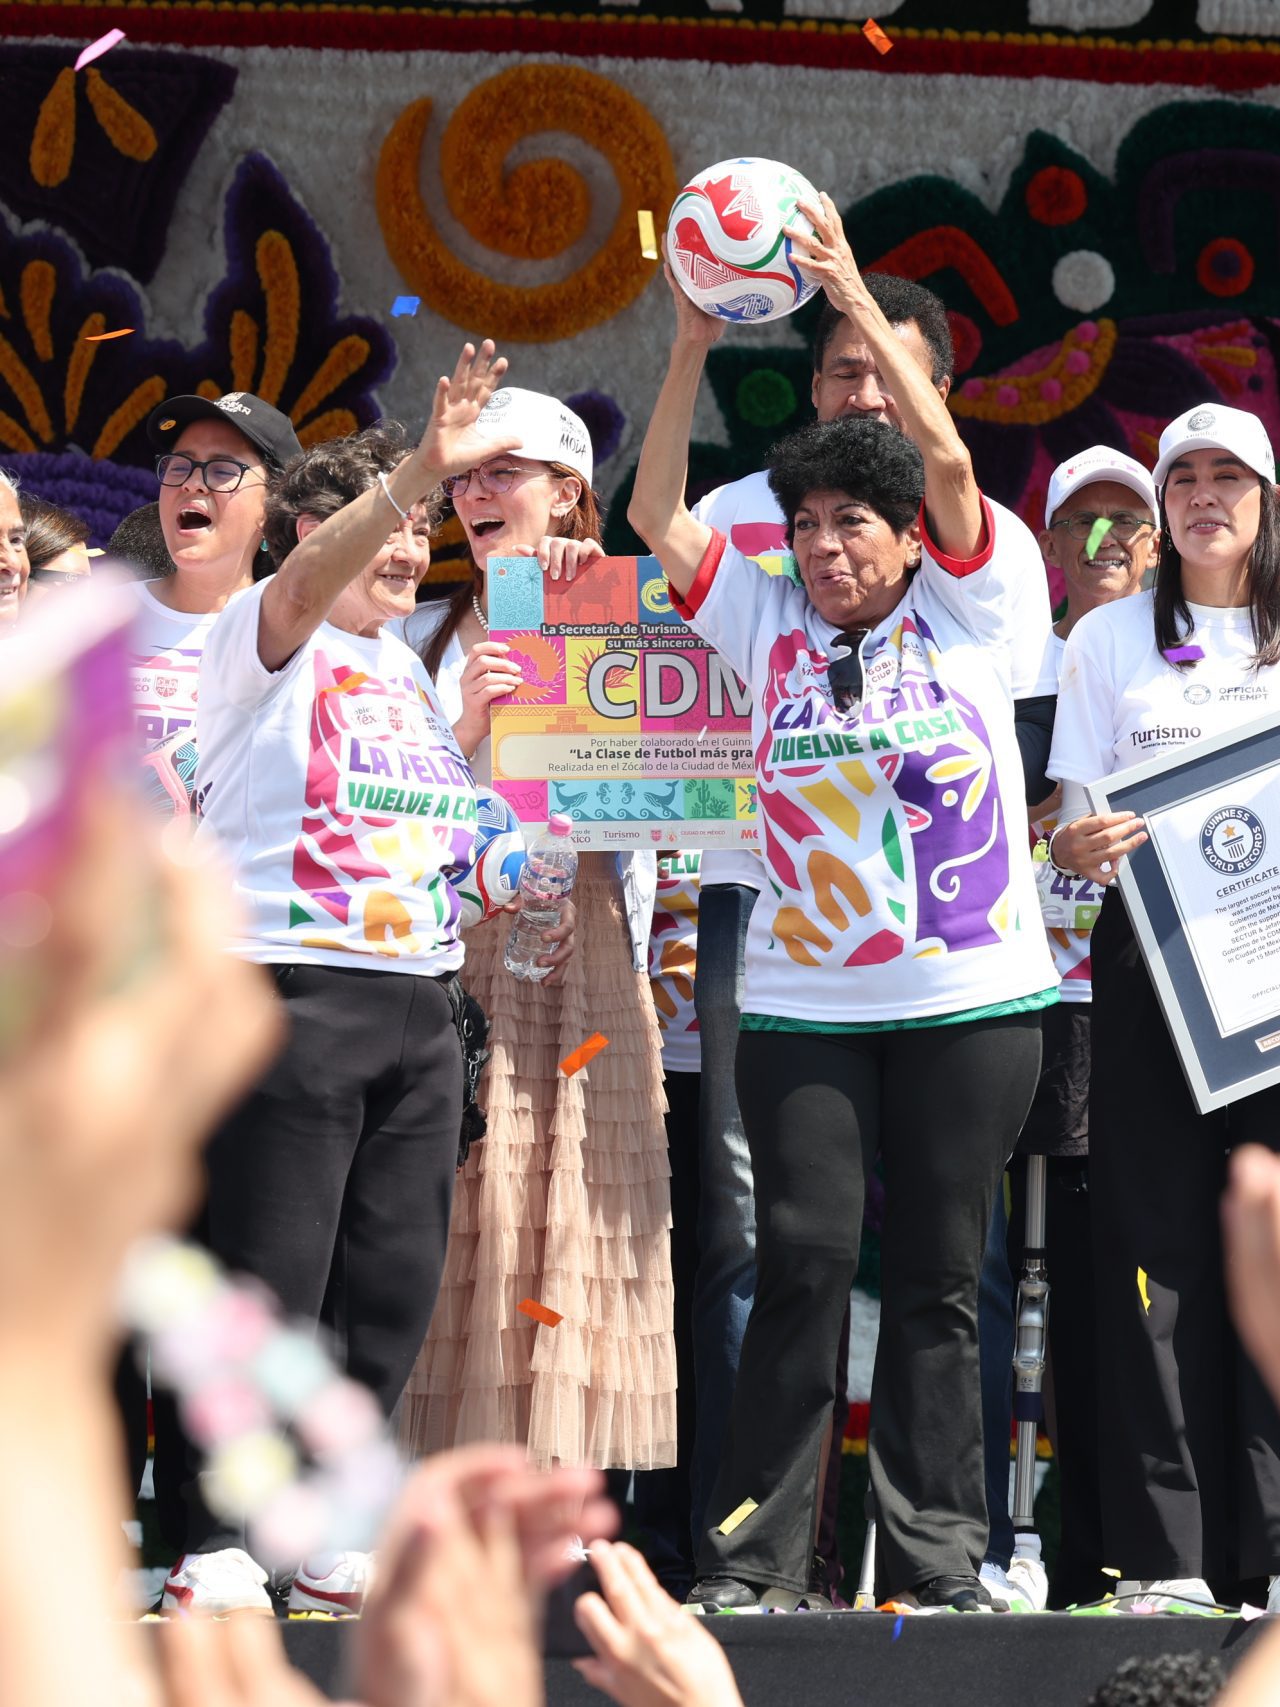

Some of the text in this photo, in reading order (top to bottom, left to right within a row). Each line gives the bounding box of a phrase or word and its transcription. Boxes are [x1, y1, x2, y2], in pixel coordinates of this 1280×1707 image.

[542, 624, 689, 635] La Secretaría de Turismo
[607, 640, 622, 649] su
[624, 638, 649, 649] más
[652, 638, 695, 649] sincero
[587, 651, 753, 719] CDM
[1219, 686, 1268, 694] OFFICIAL
[1219, 693, 1269, 702] ATTEMPT
[773, 698, 813, 731] LA
[591, 739, 607, 747] Por
[610, 738, 637, 747] haber
[640, 738, 694, 747] colaborado
[711, 738, 720, 746] el
[722, 738, 752, 747] Guinn
[771, 710, 962, 763] VUELVE A CASA
[1130, 725, 1201, 746] Turismo
[349, 737, 393, 777] LA
[596, 748, 630, 759] Clase
[635, 748, 650, 758] de
[655, 748, 696, 758] Futbol
[701, 747, 727, 758] más
[731, 749, 753, 760] gra
[549, 763, 594, 772] Realizada
[611, 763, 619, 771] el
[622, 762, 653, 771] Zócalo
[656, 762, 667, 770] de
[670, 762, 679, 770] la
[681, 761, 714, 770] Ciudad
[718, 761, 729, 770] de
[732, 760, 754, 769] Méxi
[347, 782, 478, 821] VUELVE A CA
[1204, 809, 1250, 837] GUINNESS
[571, 834, 591, 843] xico
[603, 831, 640, 840] Turismo
[1204, 825, 1263, 872] WORLD RECORDS
[1216, 866, 1280, 898] CERTIFICATE
[1228, 897, 1249, 910] largest
[1250, 889, 1270, 901] soccer
[1245, 897, 1272, 912] achieved
[1273, 893, 1280, 901] by
[1229, 913, 1257, 927] Gobierno
[1233, 925, 1246, 934] with
[1248, 920, 1258, 929] the
[1231, 930, 1257, 944] SECTUR
[1222, 942, 1250, 957] Gobierno
[1235, 948, 1257, 960] Ciudad
[1258, 943, 1265, 951] de
[1256, 954, 1264, 962] 15
